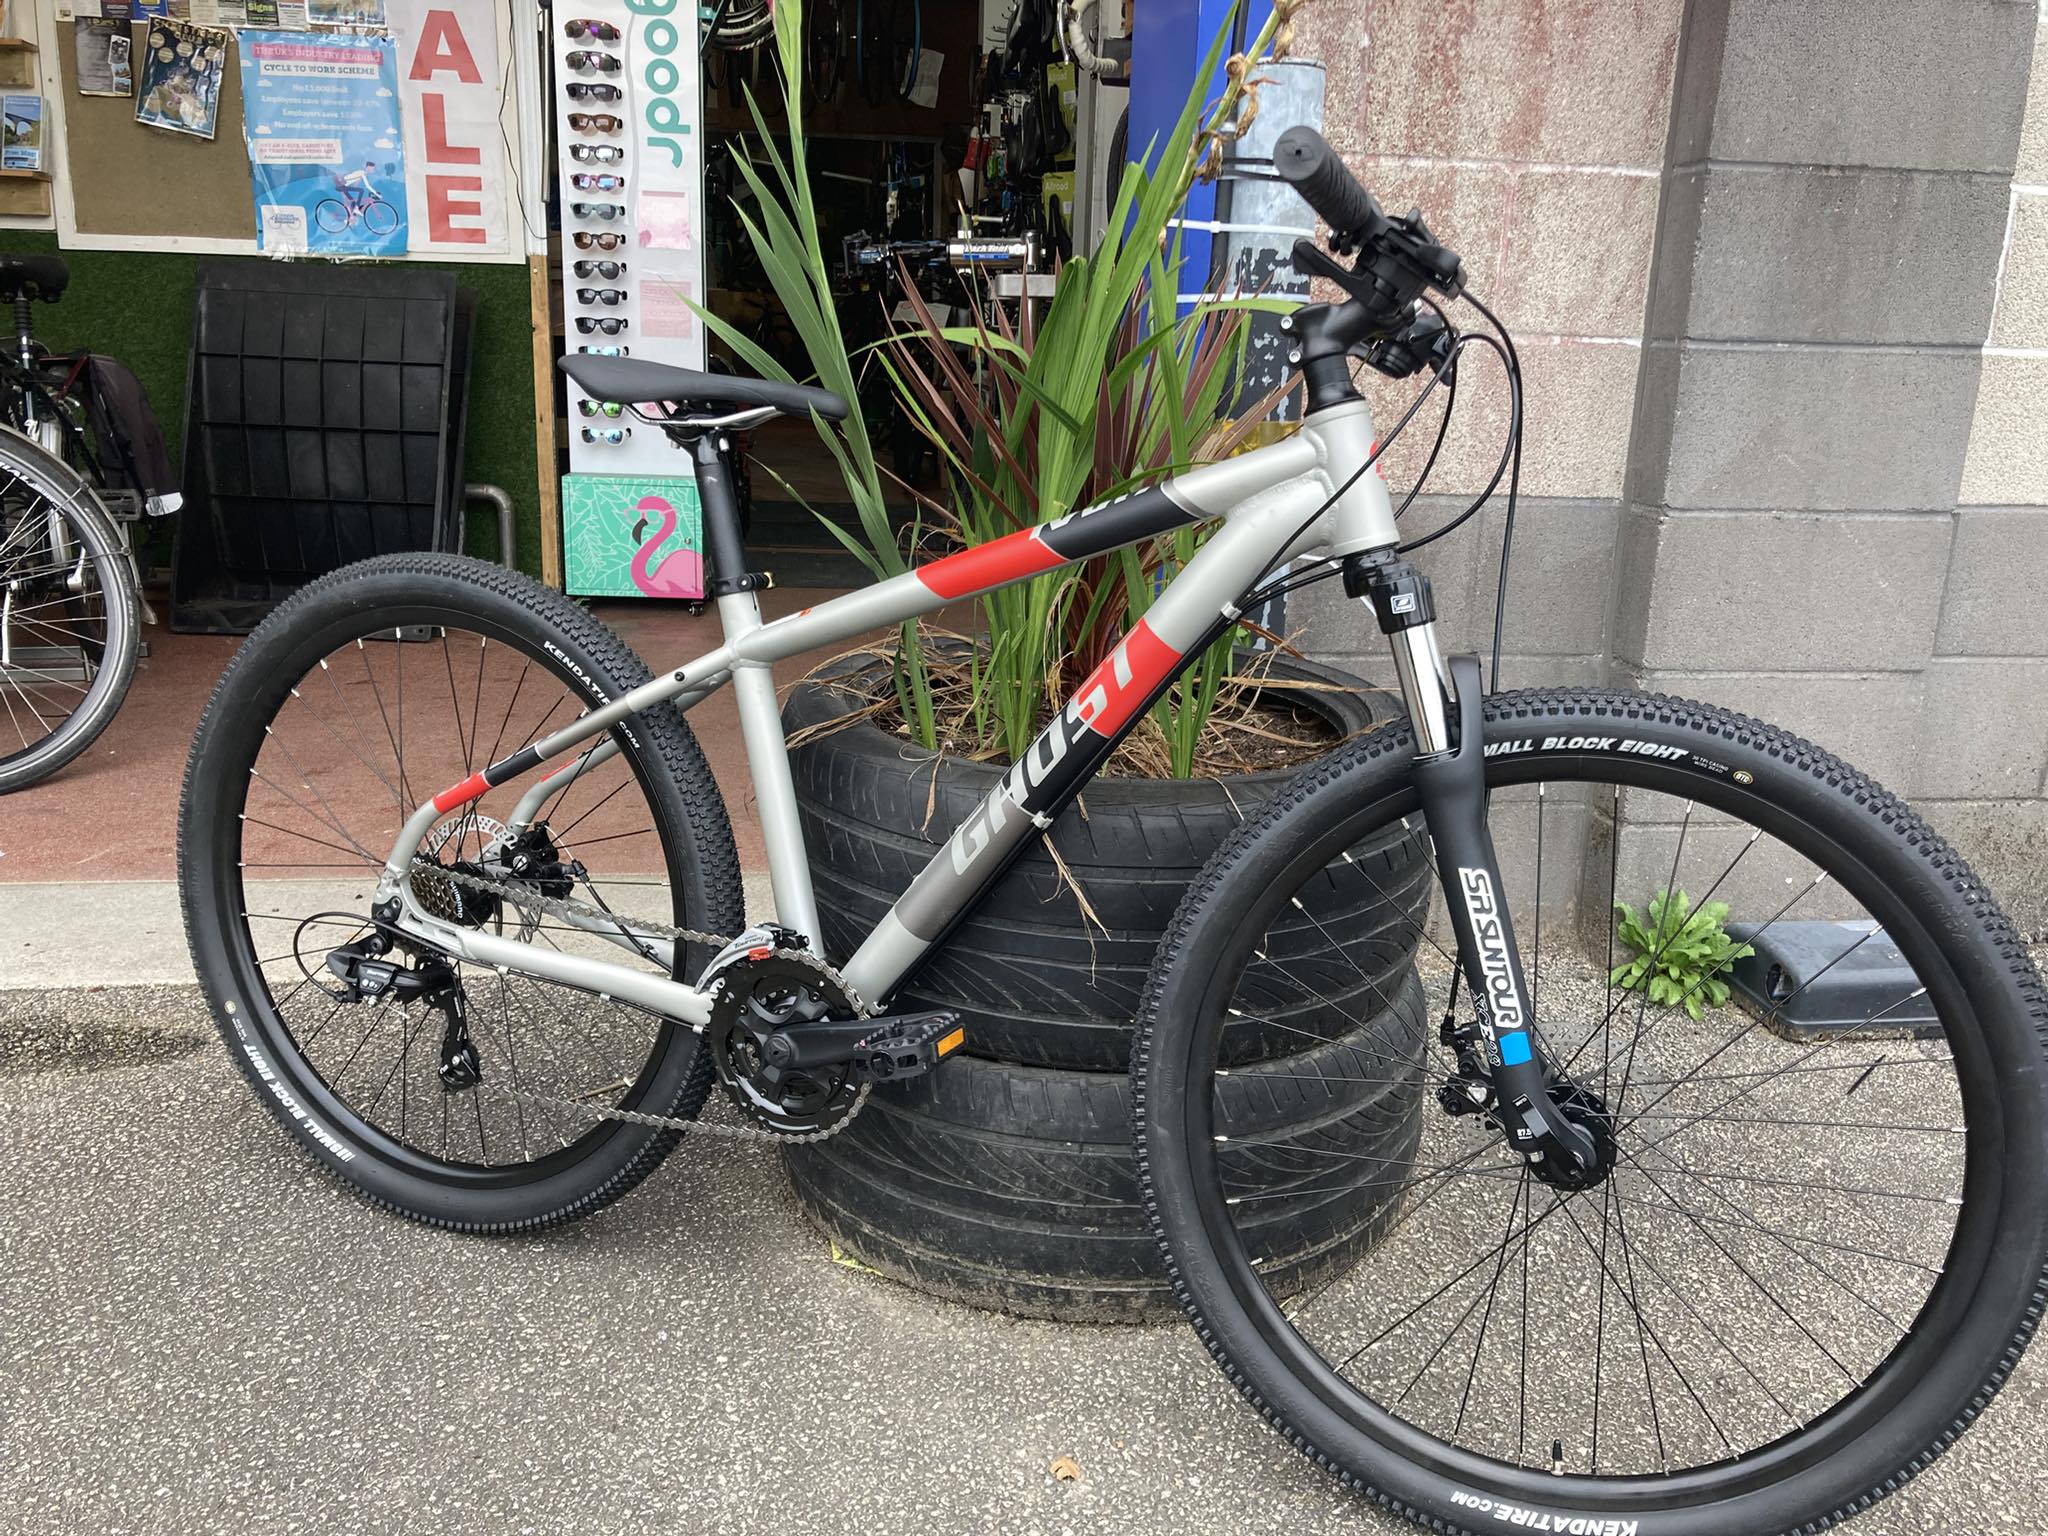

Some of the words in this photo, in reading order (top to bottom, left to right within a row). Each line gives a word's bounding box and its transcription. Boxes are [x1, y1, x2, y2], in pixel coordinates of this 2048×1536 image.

[264, 64, 292, 72] CYCLE
[294, 65, 306, 73] TO
[308, 66, 336, 74] WORK
[338, 67, 375, 75] SCHEME
[951, 624, 1140, 876] GHOST
[1484, 738, 1535, 758] MALL
[1541, 736, 1618, 751] BLOCK
[1617, 739, 1689, 762] EIGHT
[1474, 918, 1523, 1029] SUNTOUR
[243, 1044, 276, 1081] EIGHT
[268, 1081, 308, 1120] BLOCK
[1450, 1490, 1640, 1536] KENDATIRE.COM
